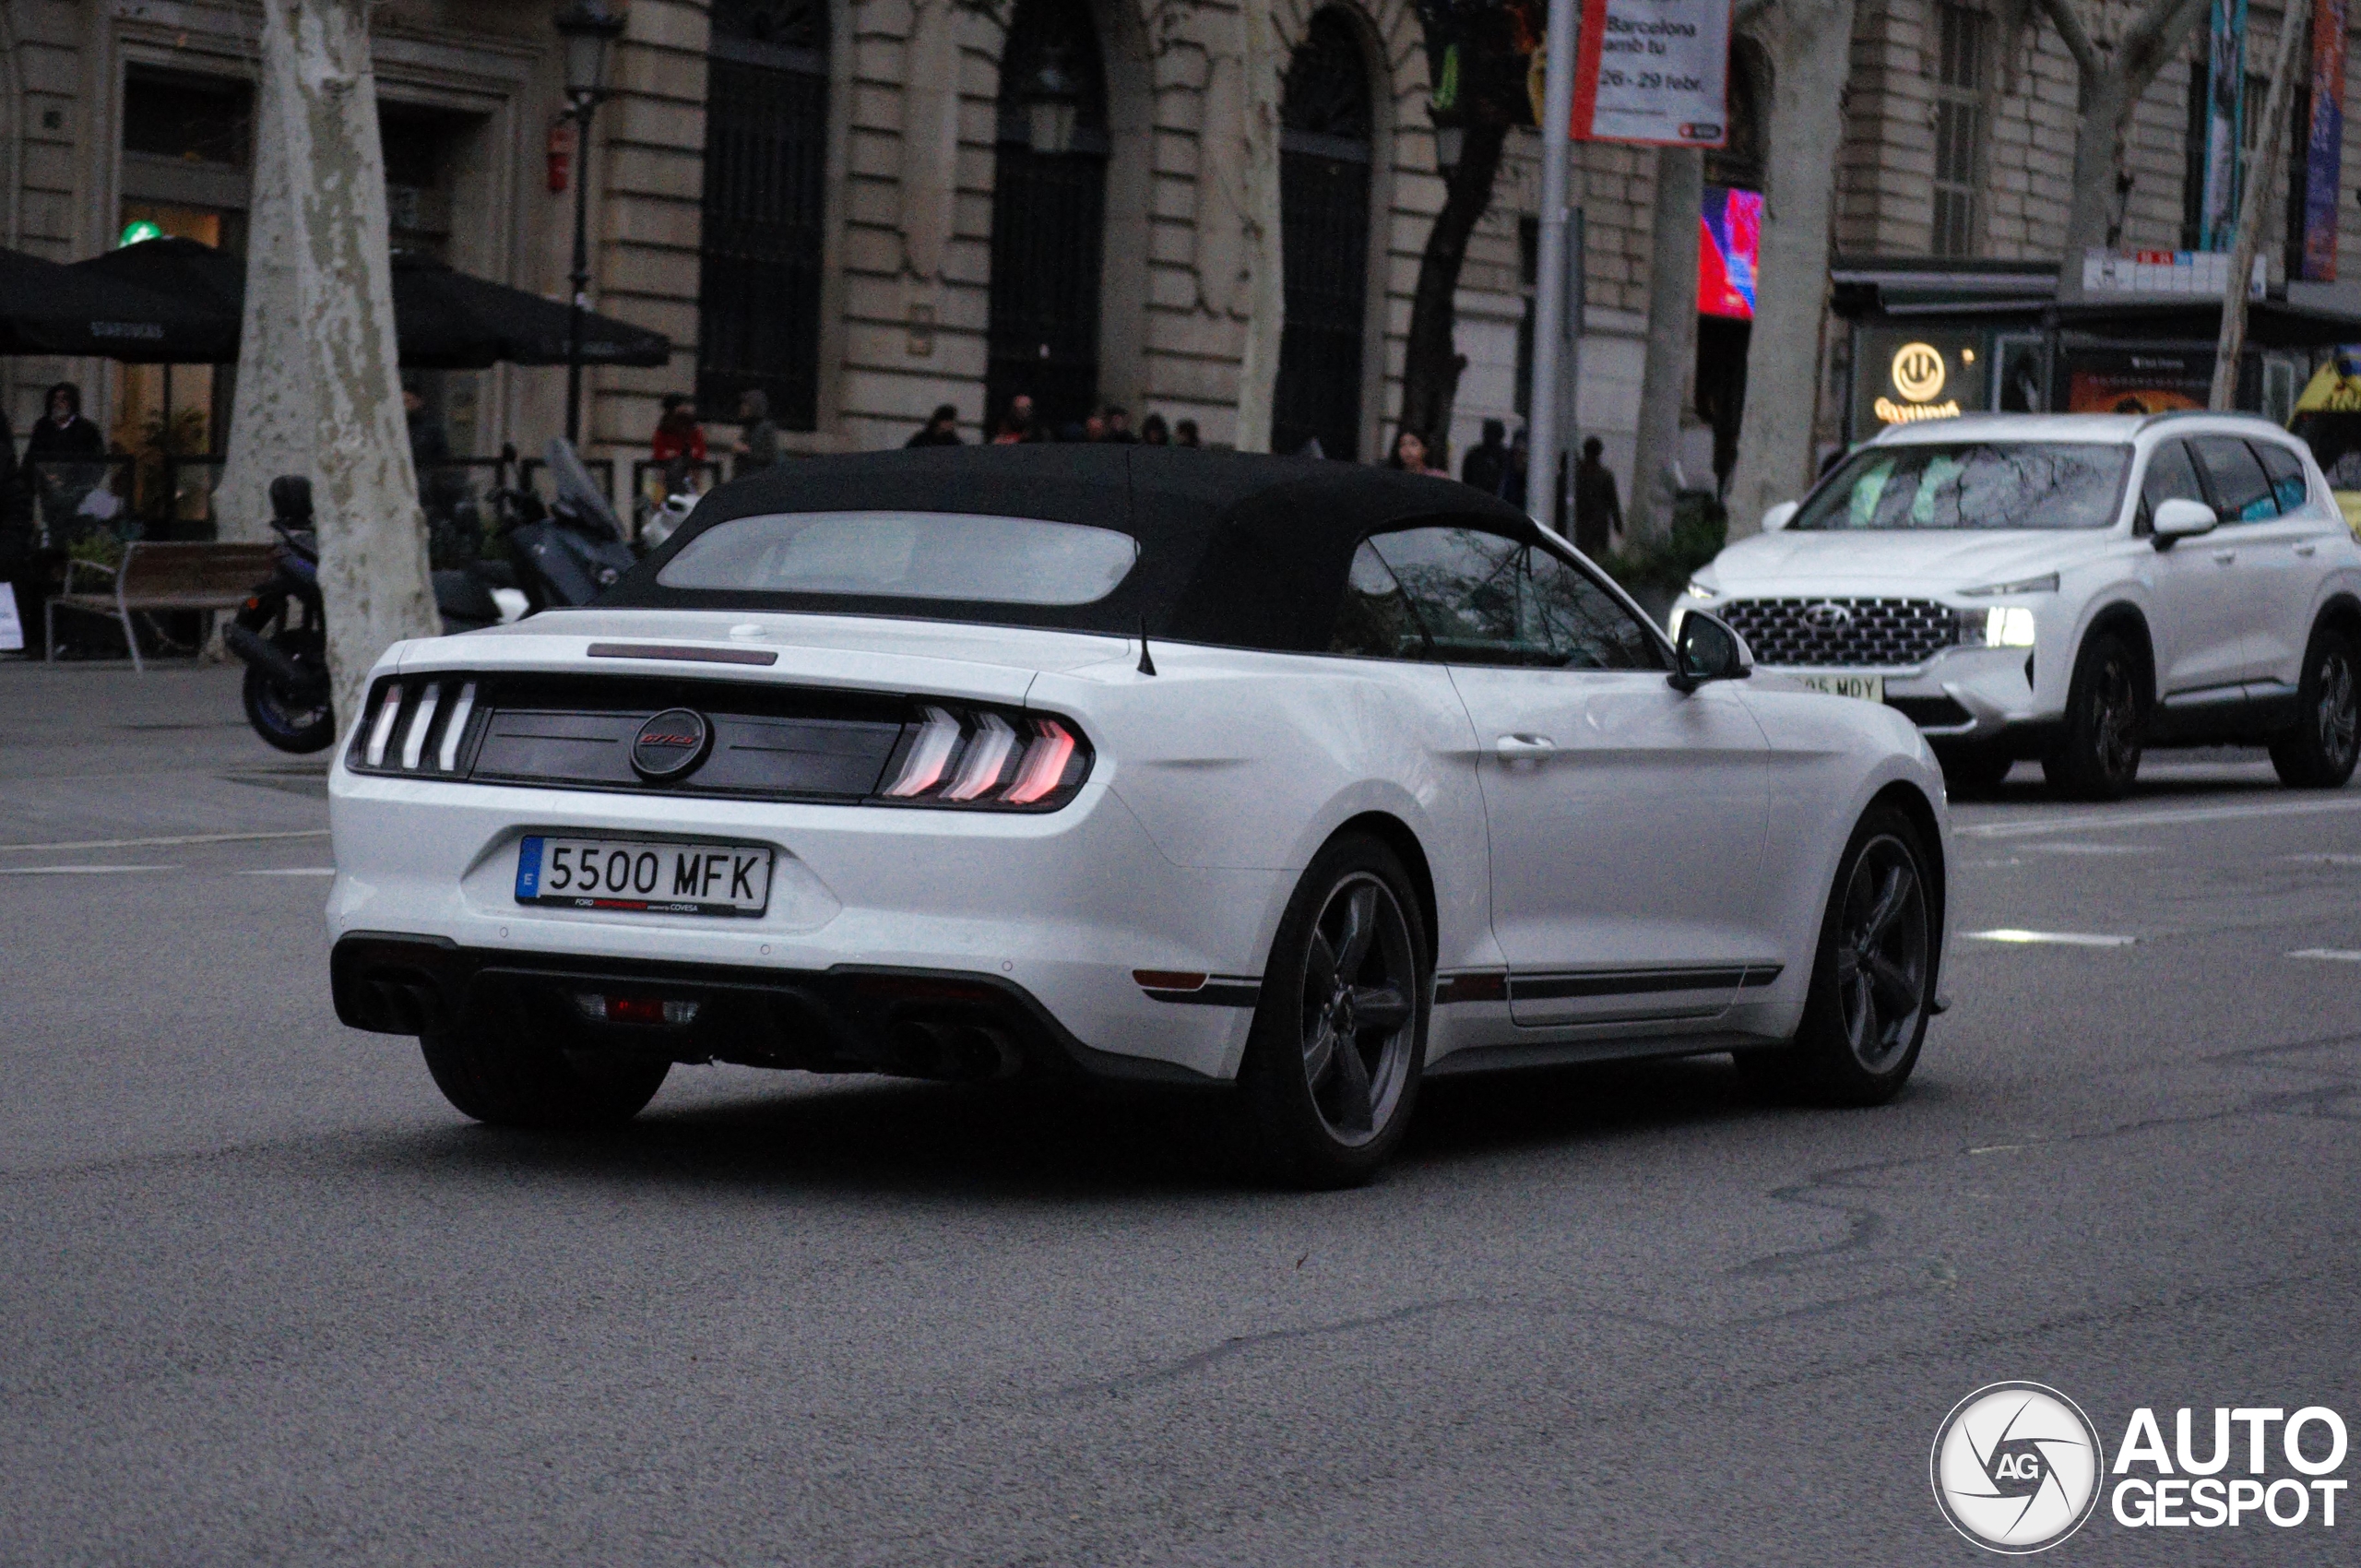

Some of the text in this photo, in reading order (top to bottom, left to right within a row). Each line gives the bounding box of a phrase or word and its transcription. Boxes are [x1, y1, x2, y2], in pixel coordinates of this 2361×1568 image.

[1607, 16, 1696, 37] Barcelona
[1603, 38, 1667, 54] amb tu
[1600, 69, 1623, 87] 26
[1637, 72, 1662, 89] 29
[1837, 678, 1874, 699] MDY
[524, 873, 534, 885] E
[549, 847, 759, 899] 5500 MFK
[575, 898, 594, 907] FORD
[670, 903, 698, 911] COVESA
